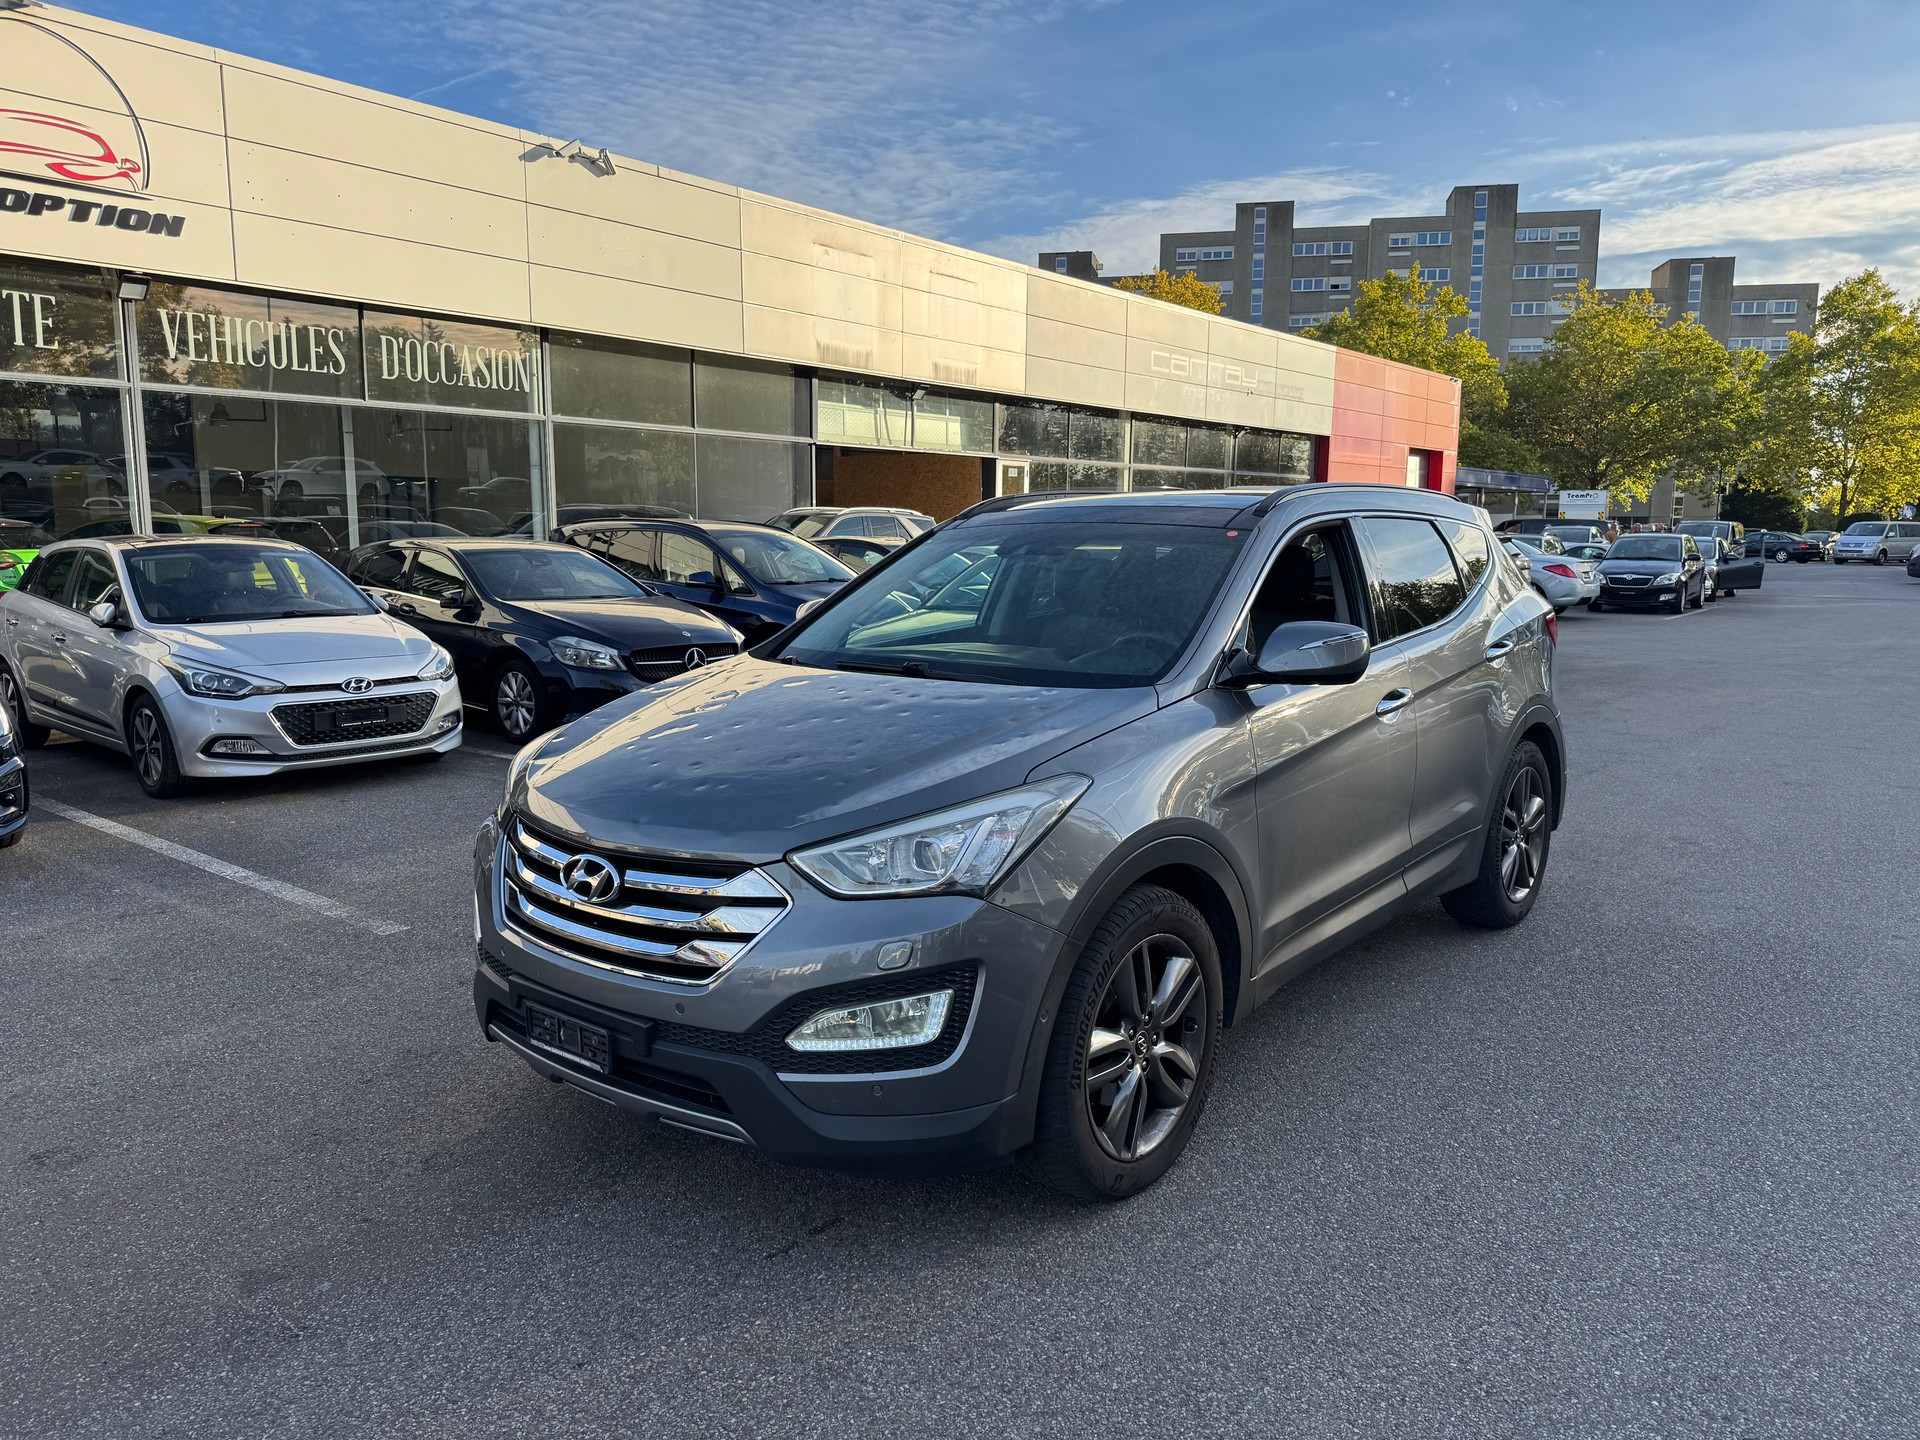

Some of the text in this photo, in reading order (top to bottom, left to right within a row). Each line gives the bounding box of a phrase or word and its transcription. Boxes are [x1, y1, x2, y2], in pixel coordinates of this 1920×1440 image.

[0, 187, 186, 238] OPTION
[156, 308, 347, 376] VEHICULES
[379, 334, 531, 394] D'OCCASION
[1151, 350, 1258, 388] carray
[1069, 949, 1117, 1091] BRIDGESTONE
